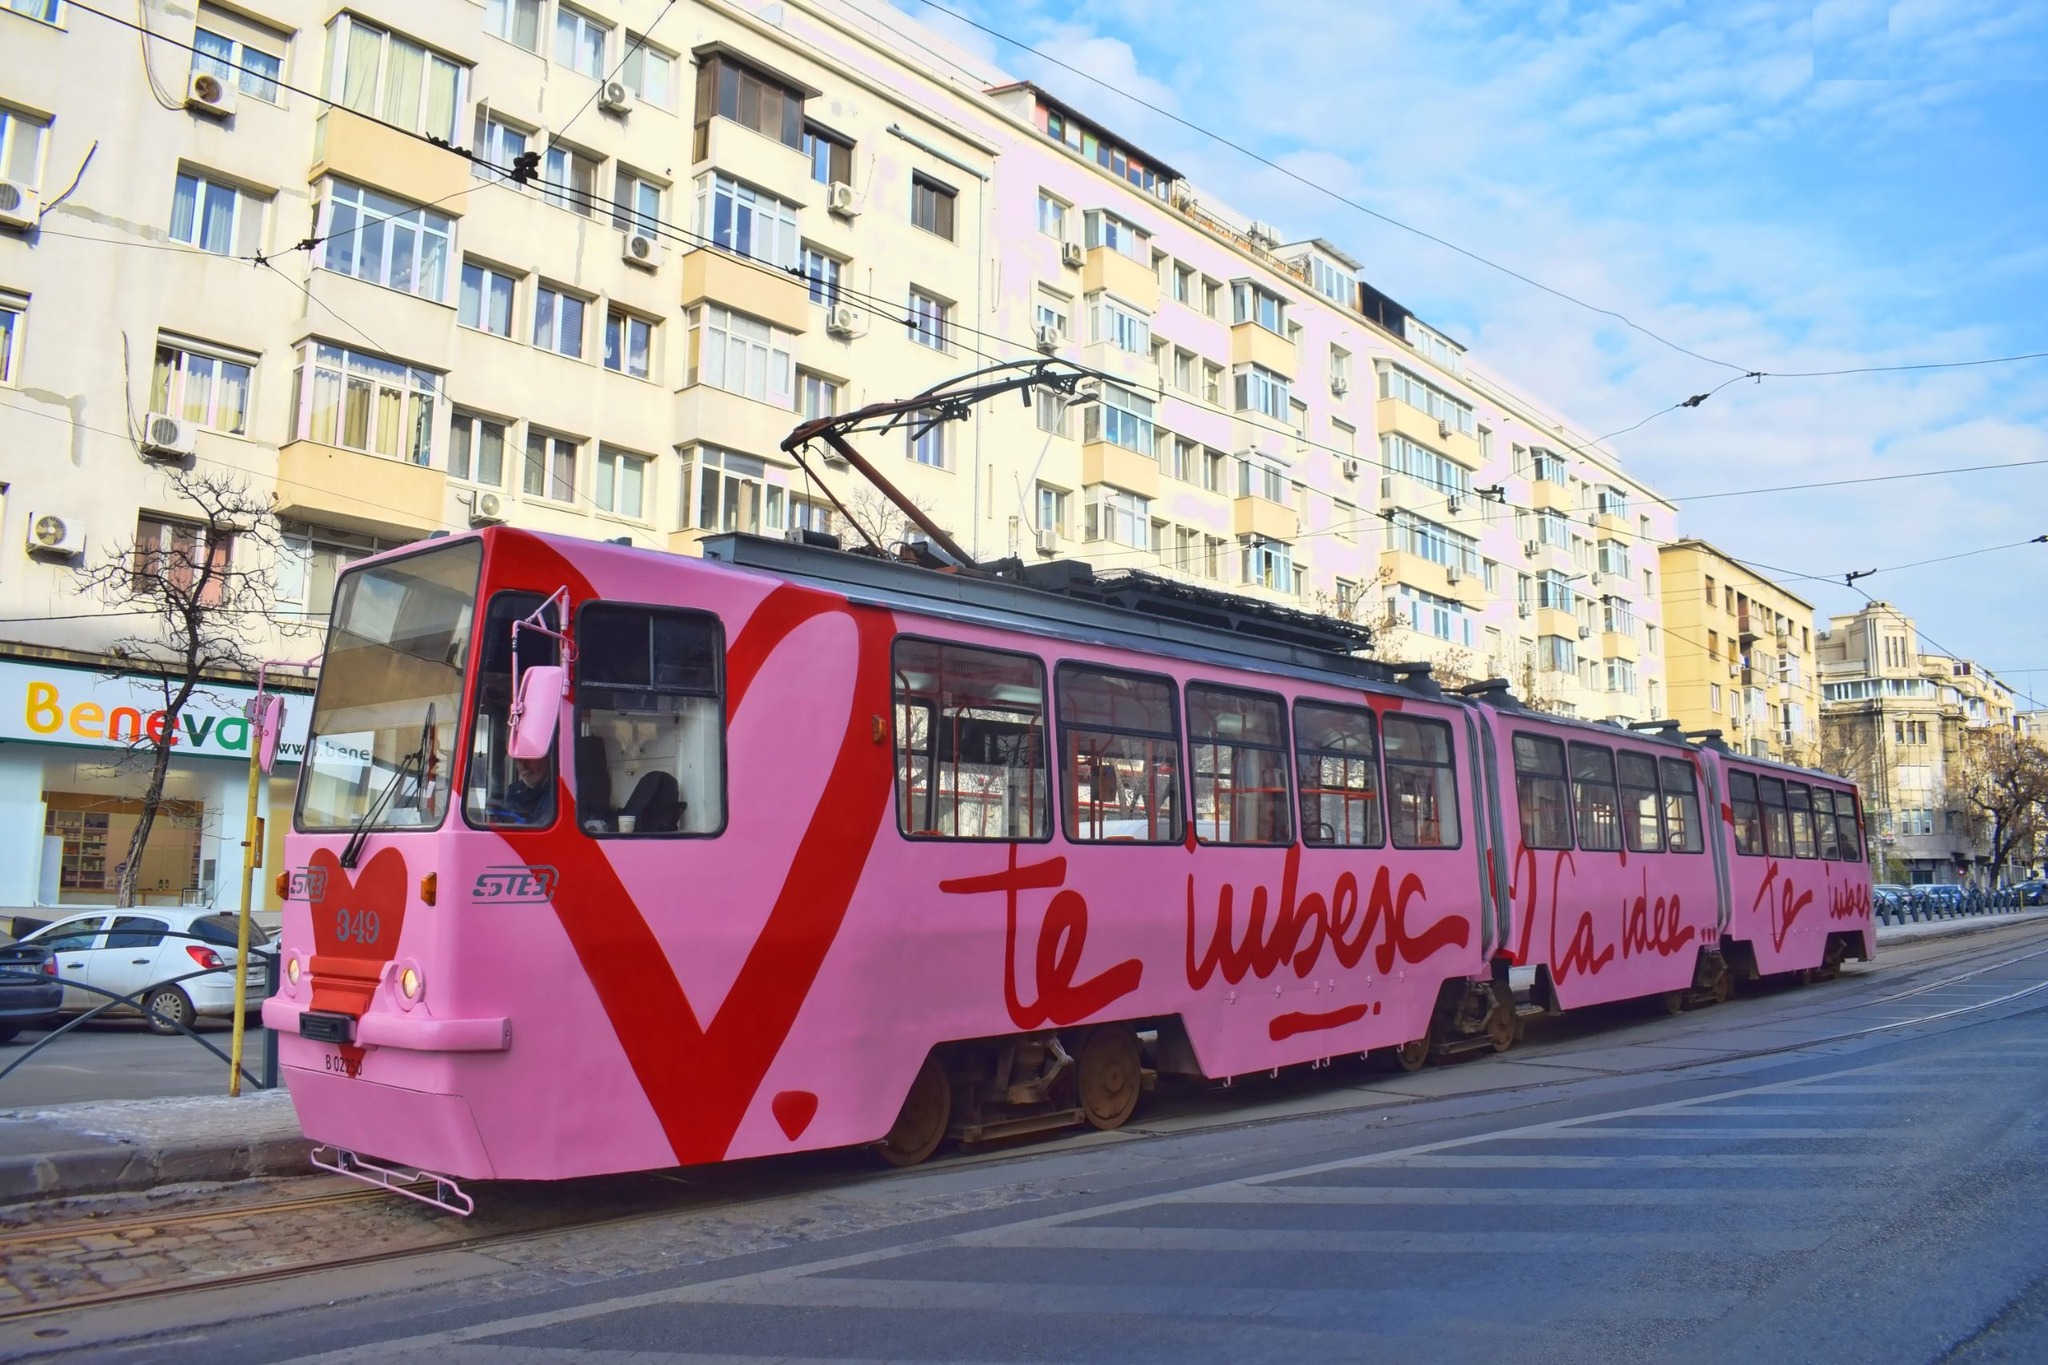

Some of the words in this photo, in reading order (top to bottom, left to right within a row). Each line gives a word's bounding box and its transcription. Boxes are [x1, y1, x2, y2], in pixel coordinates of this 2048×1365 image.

[25, 681, 249, 752] Beneva
[336, 908, 380, 944] 349
[1186, 821, 1470, 990] iubesc
[325, 1054, 332, 1070] B
